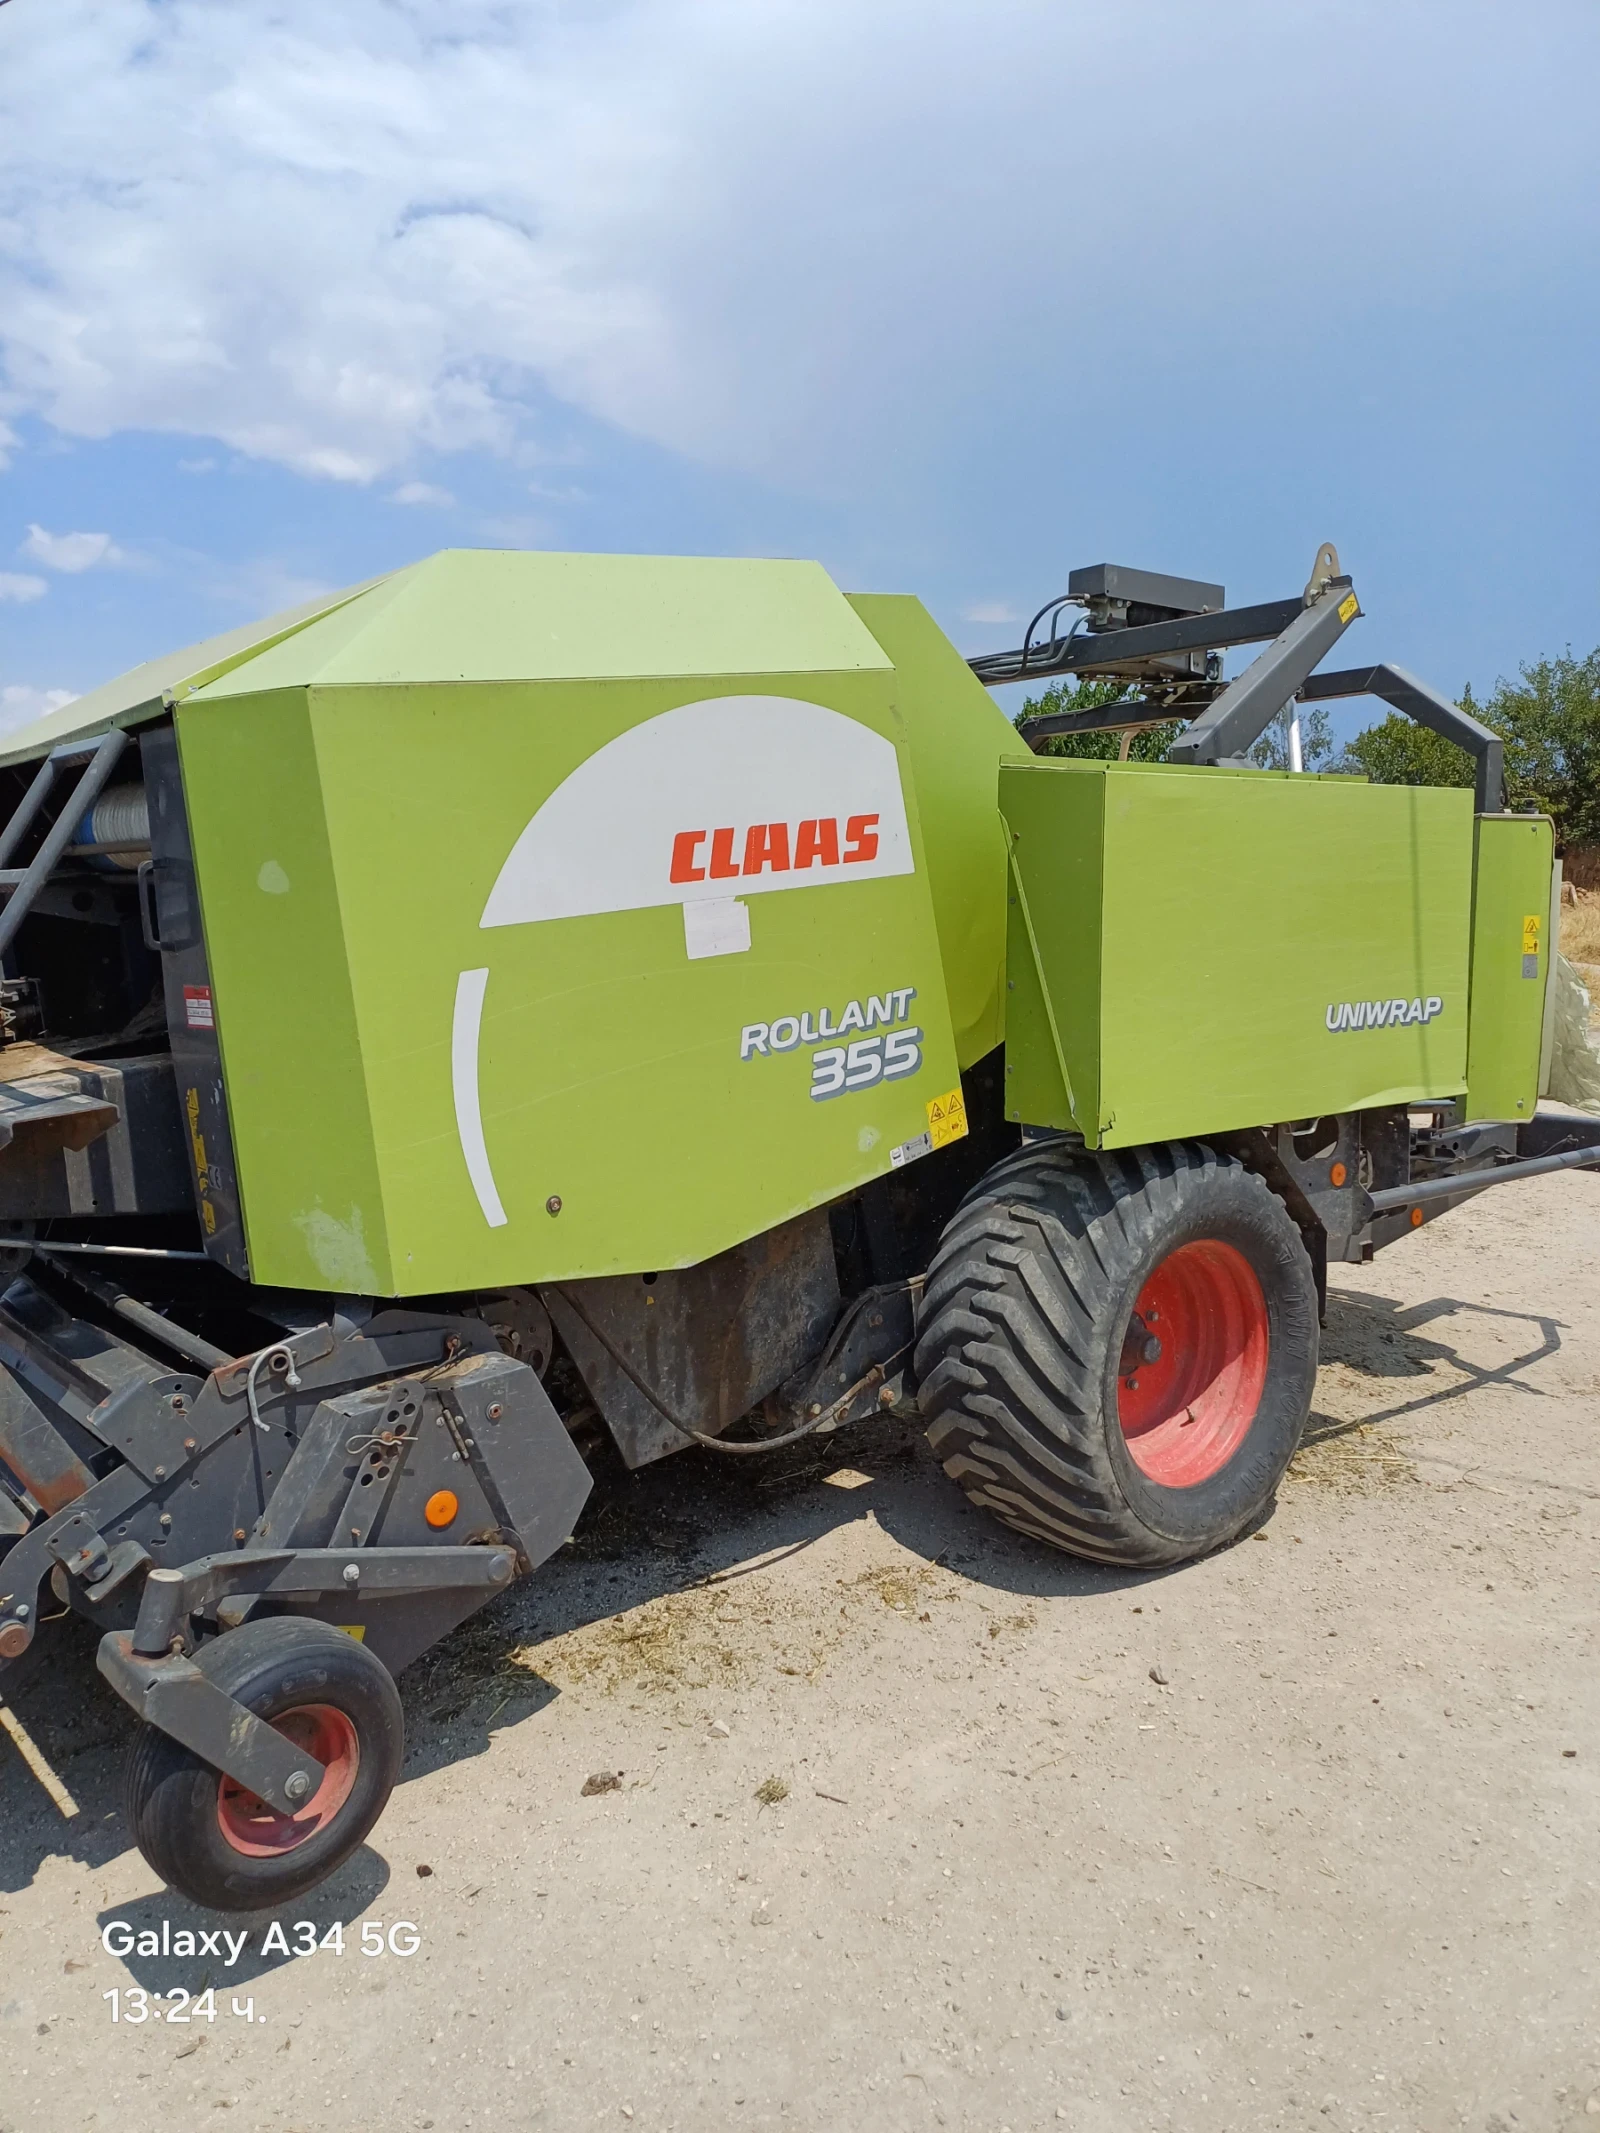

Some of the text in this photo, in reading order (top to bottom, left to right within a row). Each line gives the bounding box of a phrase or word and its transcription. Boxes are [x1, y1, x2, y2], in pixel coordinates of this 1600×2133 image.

[669, 813, 880, 884] CLAAS
[740, 986, 917, 1062] ROLLANT
[1325, 996, 1443, 1033] UNIWRAP
[809, 1026, 924, 1103] 355
